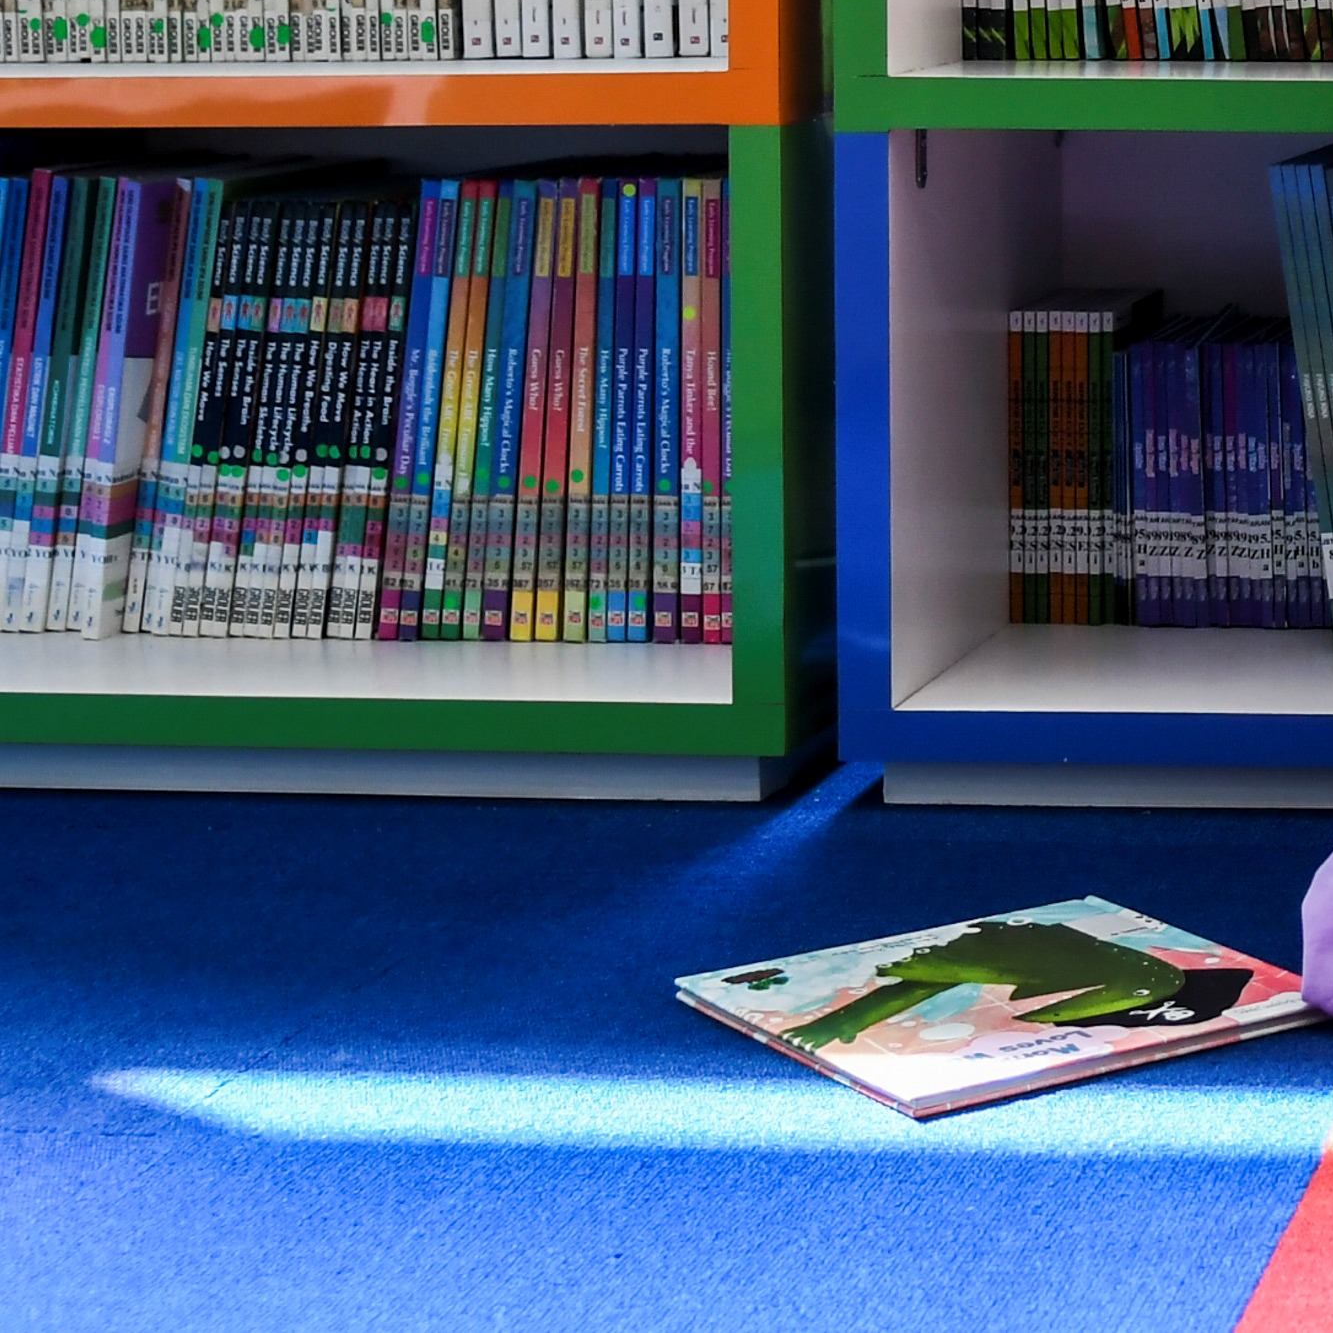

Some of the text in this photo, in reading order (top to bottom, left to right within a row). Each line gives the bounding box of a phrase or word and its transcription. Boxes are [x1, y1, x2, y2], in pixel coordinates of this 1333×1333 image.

[318, 245, 330, 285] Science
[372, 340, 382, 359] The
[319, 342, 338, 423] Digesting Food
[334, 341, 352, 423] How We Move
[368, 362, 380, 394] Heart
[363, 410, 374, 444] Action
